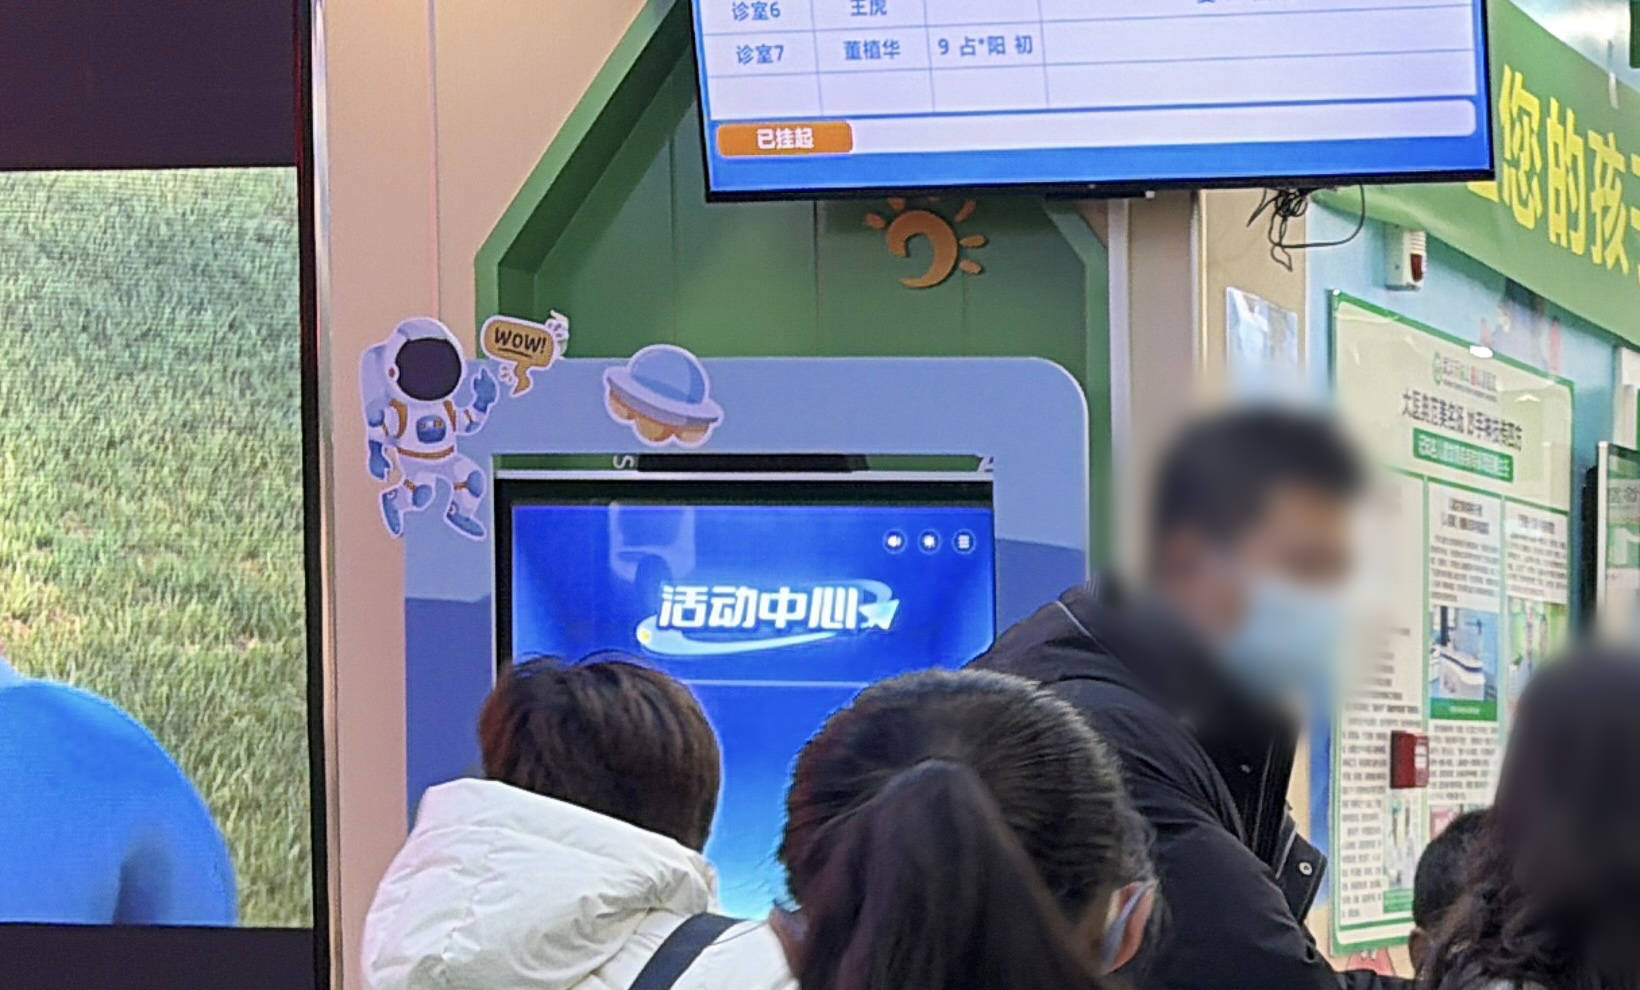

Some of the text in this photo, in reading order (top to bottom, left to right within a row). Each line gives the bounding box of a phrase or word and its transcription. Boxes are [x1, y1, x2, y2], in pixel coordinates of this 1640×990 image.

[732, 1, 781, 21] 诊室6
[735, 44, 785, 65] 诊室7
[937, 38, 950, 55] 9
[756, 127, 815, 150] 已挂起
[494, 326, 547, 354] WOW!
[658, 584, 859, 631] 活动中心
